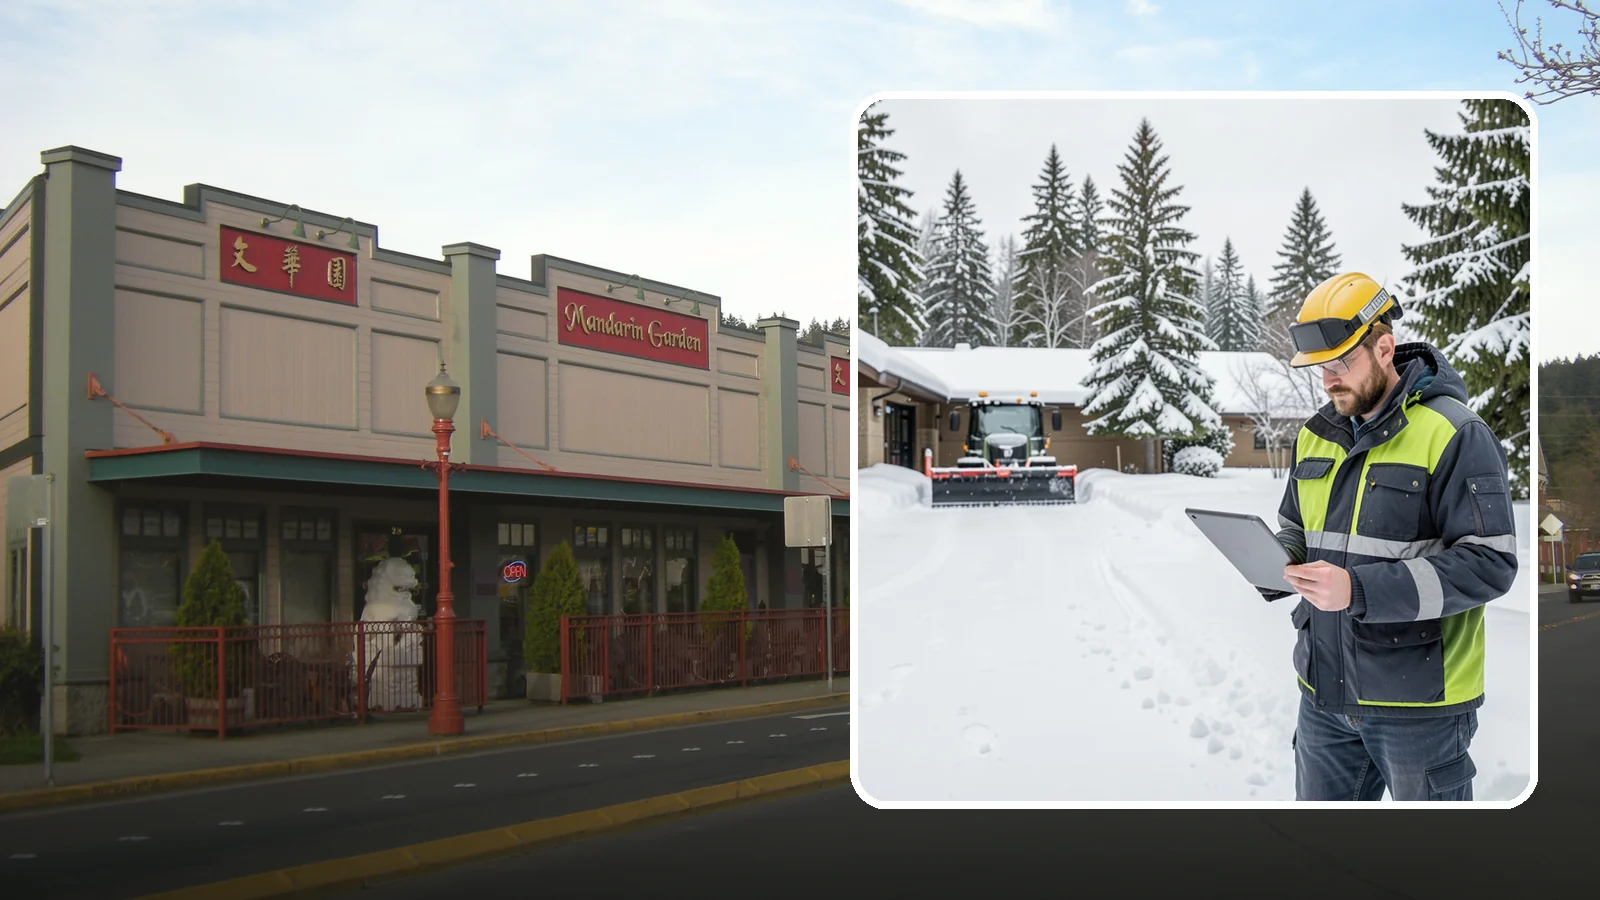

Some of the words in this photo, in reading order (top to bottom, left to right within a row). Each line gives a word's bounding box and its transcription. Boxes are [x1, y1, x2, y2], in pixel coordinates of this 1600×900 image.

[231, 236, 346, 291] 文華園
[564, 302, 644, 341] Mandarin
[647, 320, 702, 352] Garden
[503, 565, 527, 578] OPEN
